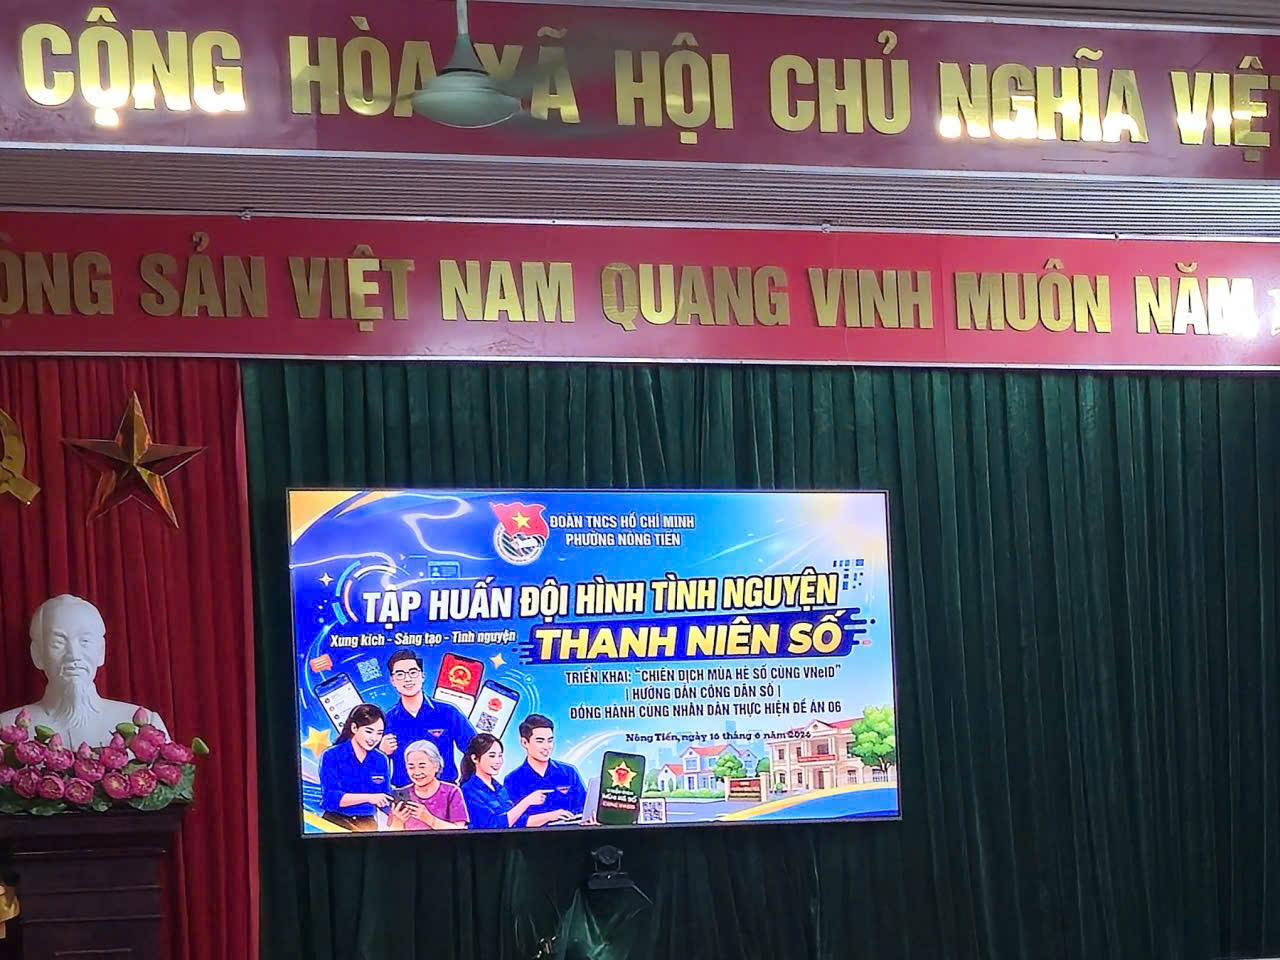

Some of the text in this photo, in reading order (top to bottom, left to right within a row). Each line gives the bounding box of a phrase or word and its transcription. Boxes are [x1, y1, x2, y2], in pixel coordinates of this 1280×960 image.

[21, 6, 246, 127] CỘNG
[288, 16, 437, 118] HÒA
[615, 32, 736, 144] HỘI
[769, 30, 911, 135] CHỦ
[938, 48, 1150, 143] NGHĨA
[139, 232, 269, 319] SẢN
[288, 244, 415, 332] VIỆT
[439, 258, 575, 323] NAM
[600, 261, 789, 332] QUANG
[807, 267, 933, 329] VINH
[955, 258, 1111, 333] MUÔN
[1135, 261, 1259, 337] NĂM
[550, 512, 583, 528] ĐOÀN
[585, 514, 617, 528] TNCS
[663, 514, 695, 528] MINH
[363, 568, 838, 629] TẬP HUẤN ĐỘI HÌNH TÌNH NGUYỆN
[331, 635, 358, 648] Xung
[361, 634, 385, 646] kích
[395, 632, 422, 646] Sáng
[425, 633, 442, 647] tạo
[477, 629, 516, 645] nguyện
[535, 609, 846, 660] THANH NIÊN SỐ
[602, 671, 632, 682] KHAI:
[678, 668, 704, 683] DỊCH
[753, 663, 767, 679] SỐ
[771, 664, 800, 679] CÙNG
[733, 702, 761, 718] THỰC
[764, 700, 790, 717] HIỆN
[828, 700, 842, 714] 06
[722, 730, 752, 742] tháng
